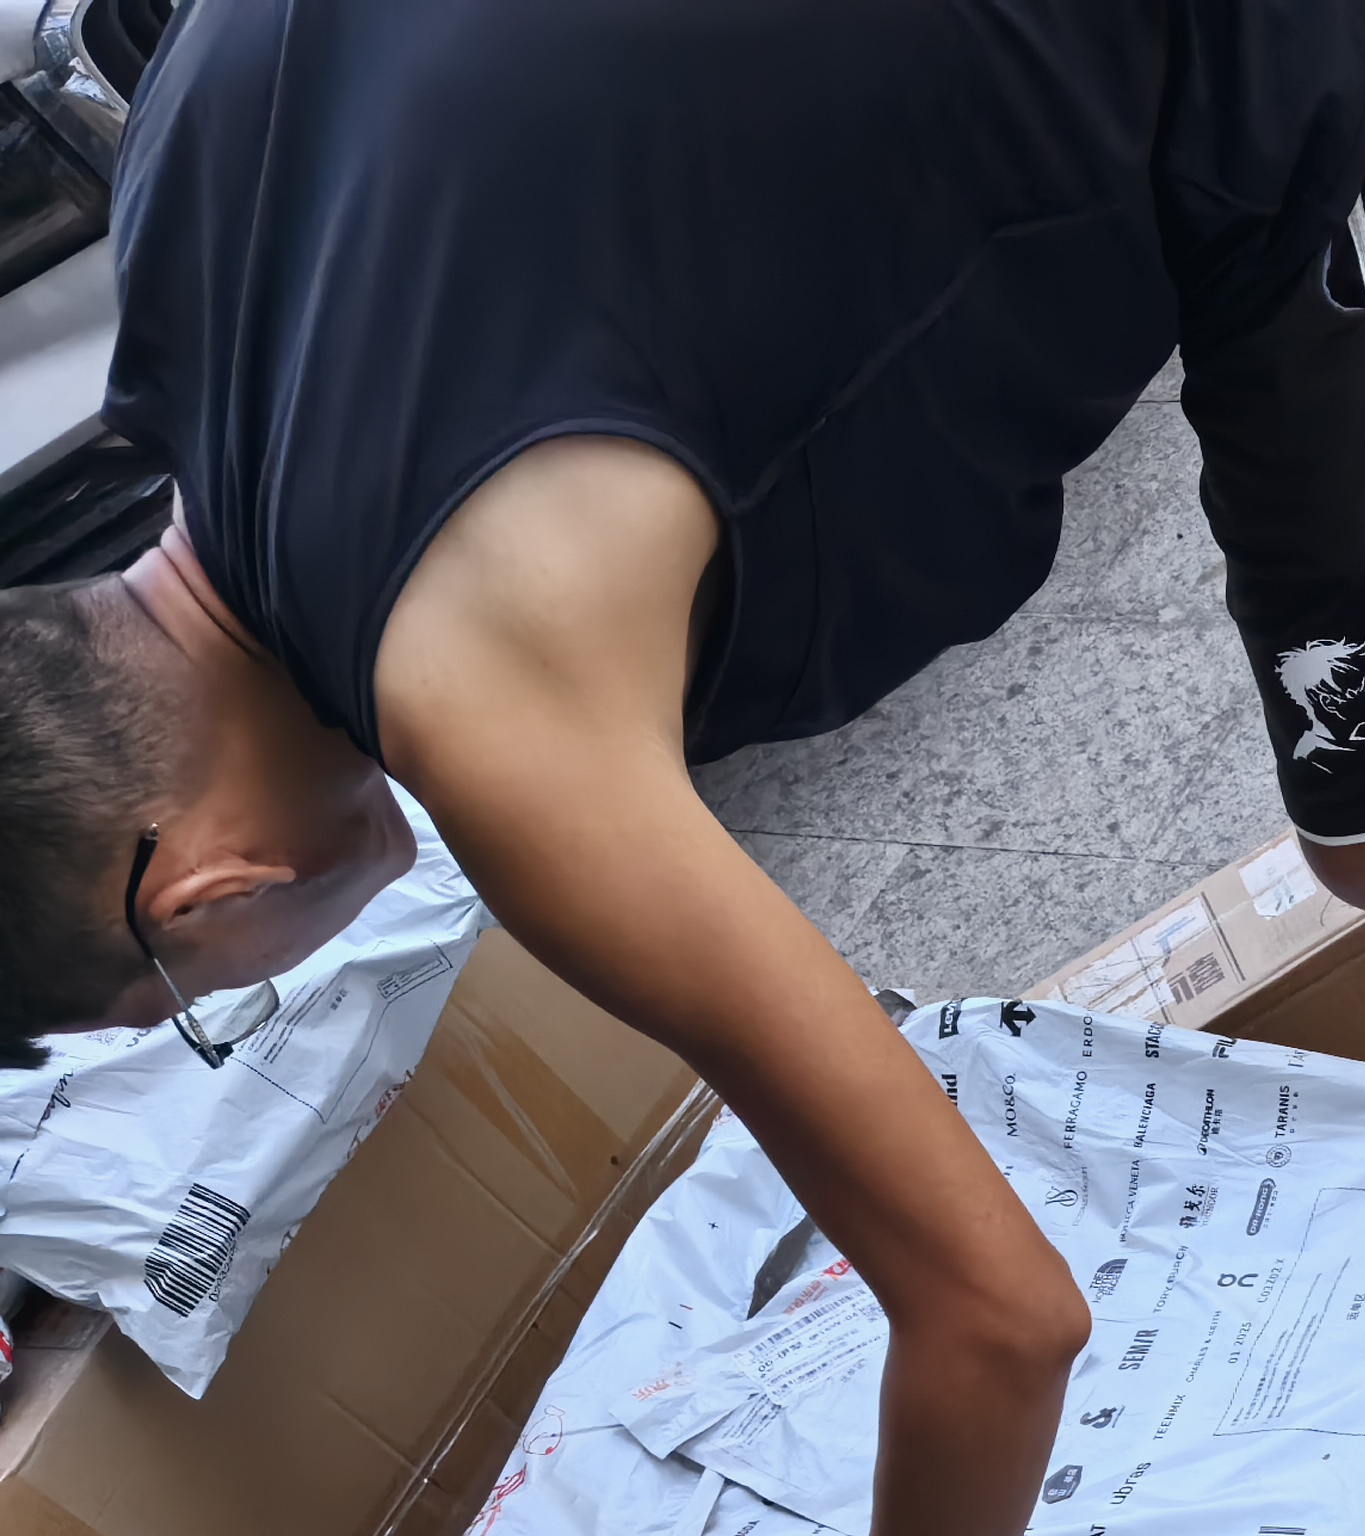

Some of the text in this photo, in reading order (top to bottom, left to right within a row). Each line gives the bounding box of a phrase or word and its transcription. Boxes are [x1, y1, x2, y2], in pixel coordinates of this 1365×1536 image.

[1064, 1070, 1087, 1149] FERRAGAMO
[1133, 1082, 1156, 1149] BALENCIAGA
[1274, 1085, 1290, 1138] TARANIS
[1118, 1328, 1160, 1371] SEMIR
[1153, 1394, 1187, 1441] TEENMIX
[1110, 1461, 1152, 1505] ubras
